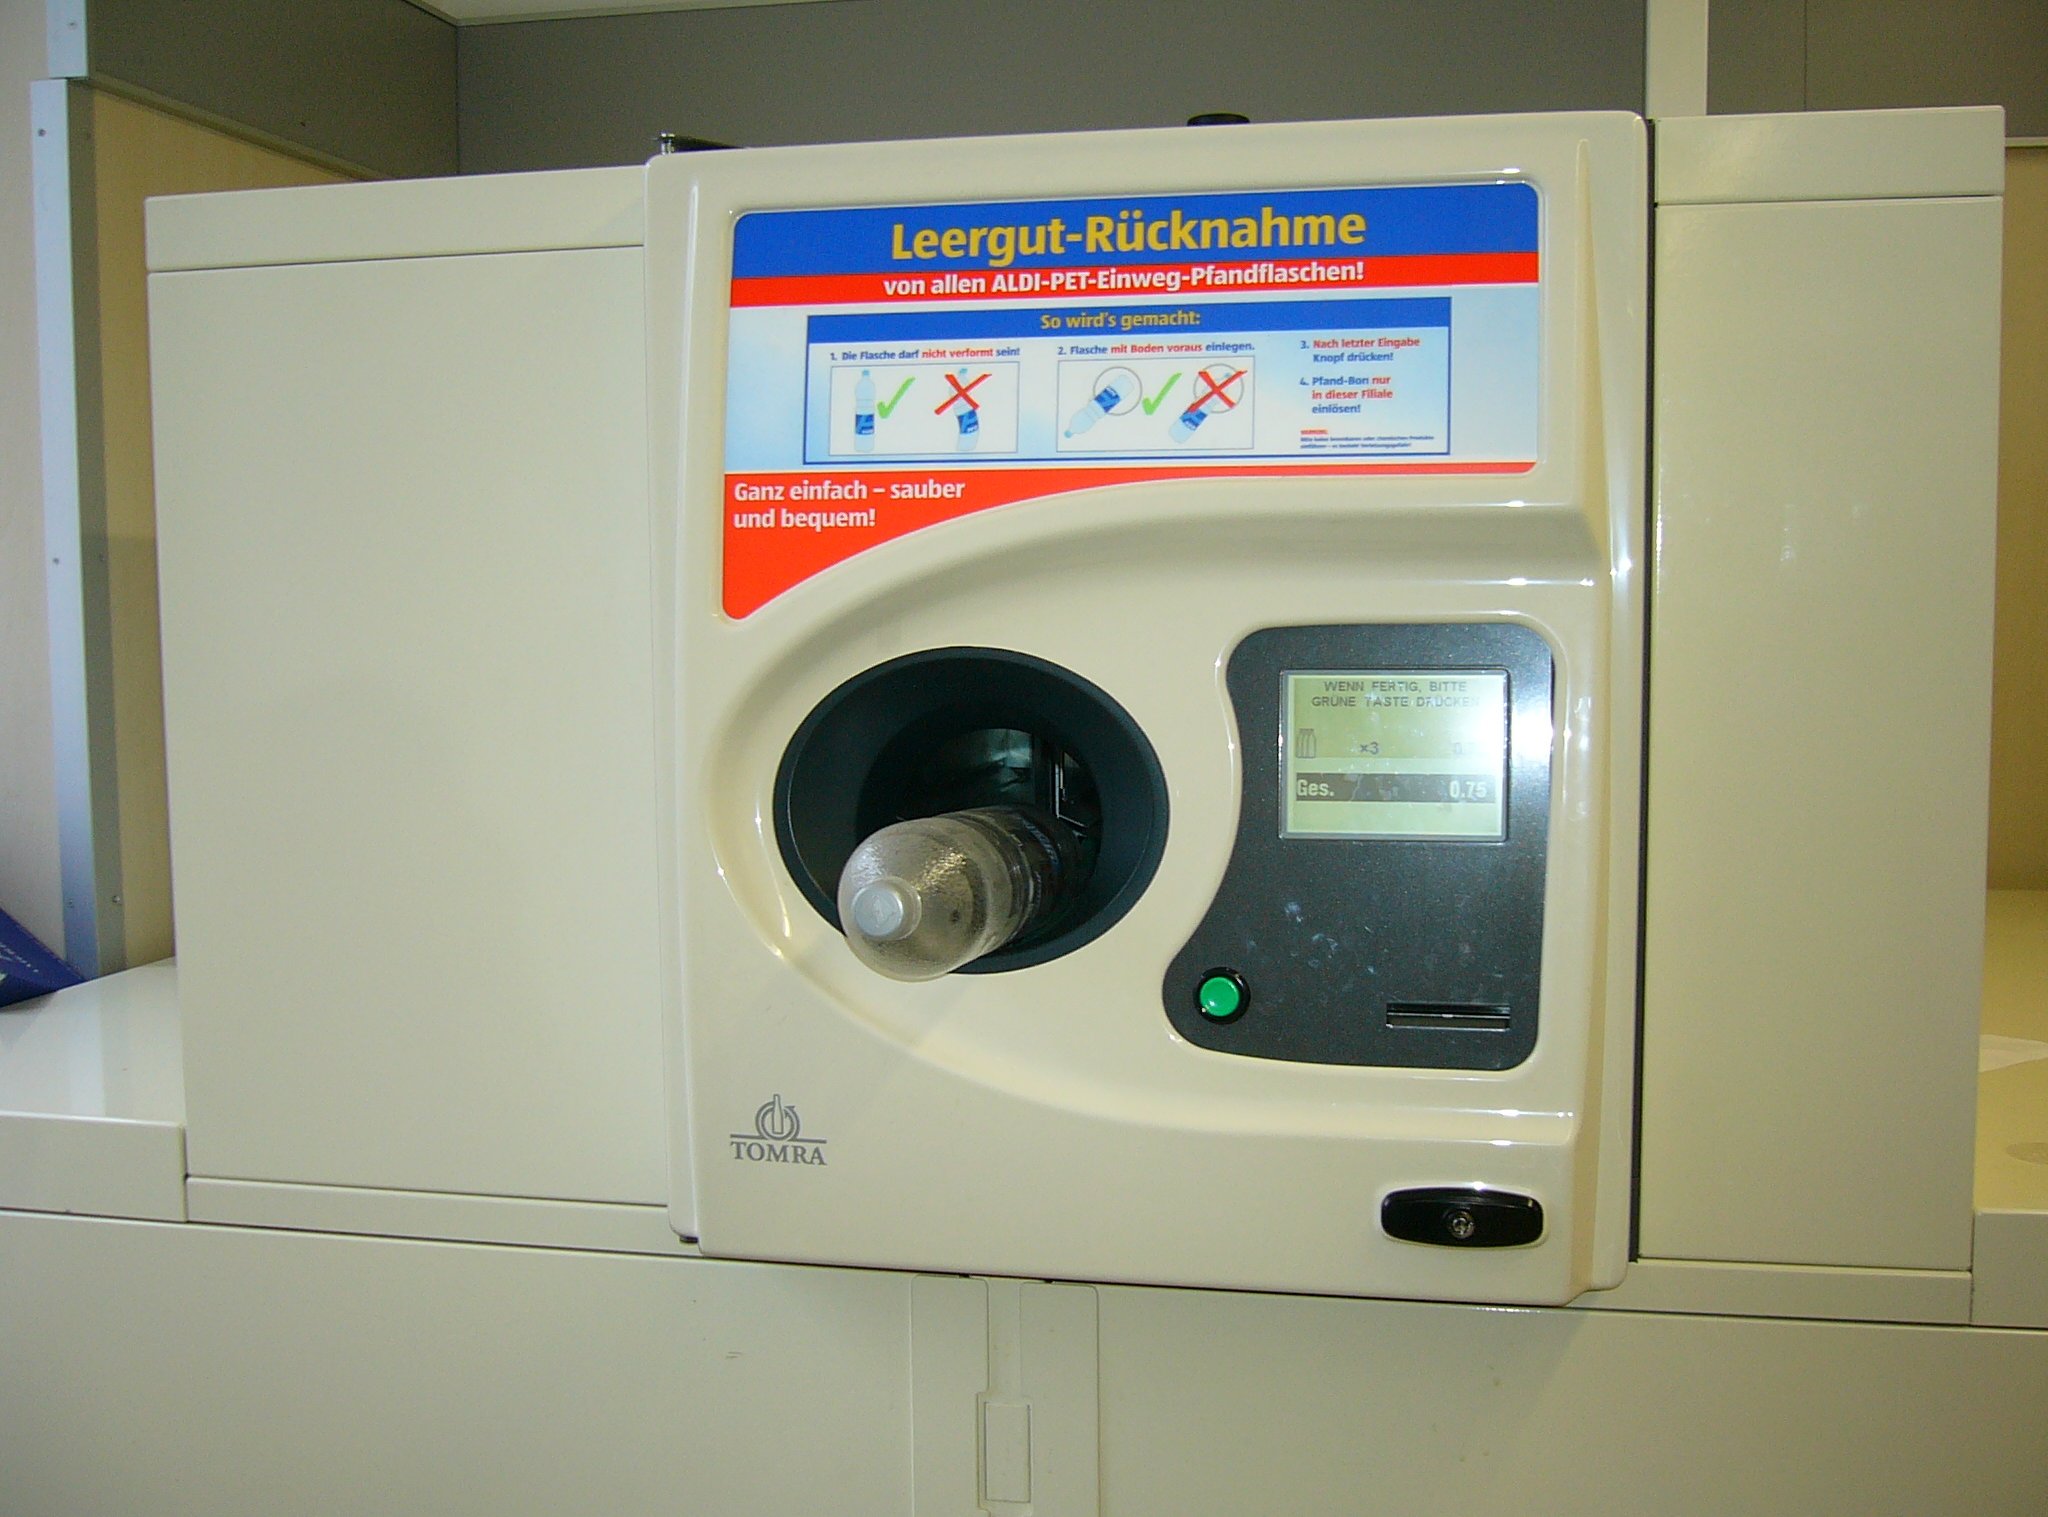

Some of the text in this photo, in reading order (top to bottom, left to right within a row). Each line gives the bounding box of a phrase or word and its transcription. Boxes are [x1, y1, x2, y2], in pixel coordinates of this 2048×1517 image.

[892, 206, 1367, 267] Leergut-Rücknahme
[883, 261, 1364, 296] von allen ALDI-PET-Einweg-Pfandflaschen!
[1041, 310, 1201, 331] So wird's gemacht:
[1057, 342, 1255, 355] 2. Flasche mit Boden voraus einlegen.
[1300, 337, 1420, 350] 3. Nach letzter Eingabe
[830, 346, 1020, 361] 1. Die Flasche darf nicht verformt sein!
[1313, 352, 1394, 364] Knopf drücken!
[1312, 375, 1369, 386] Pfand-Bon
[1372, 376, 1391, 385] nur
[1312, 388, 1393, 399] in dieser Filiale
[1312, 403, 1361, 414] einlösen!
[734, 483, 784, 501] Ganz
[790, 480, 867, 501] einfach
[890, 479, 965, 499] sauber
[734, 508, 876, 532] und bequem!
[1323, 681, 1364, 692] WENN
[1430, 681, 1467, 692] BITTE
[1365, 696, 1409, 707] TASTE
[1297, 779, 1487, 798] Ges. 0.75
[730, 1140, 828, 1166] TOMRA
